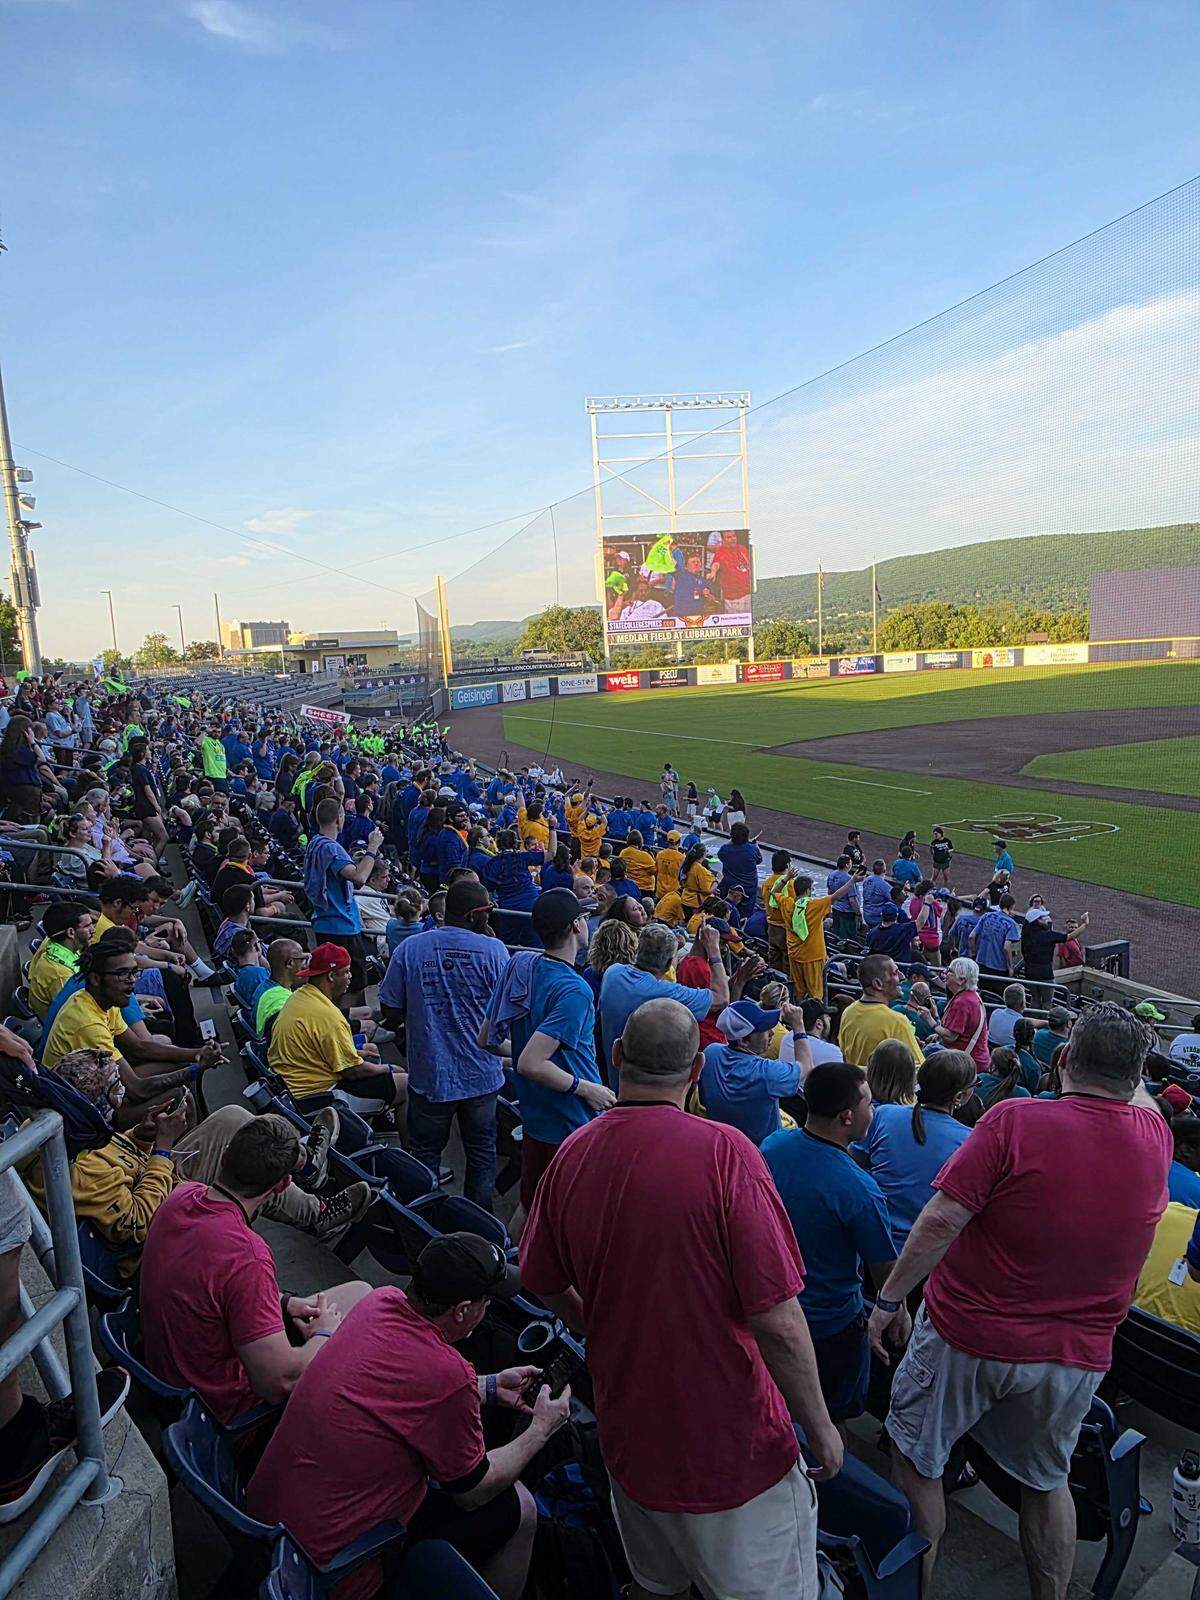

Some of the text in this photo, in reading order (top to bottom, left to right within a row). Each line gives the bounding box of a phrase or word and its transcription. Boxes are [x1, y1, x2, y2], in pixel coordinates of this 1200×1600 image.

[617, 627, 742, 642] MEDLAR FIELD AT LUBRANO PARK
[608, 673, 638, 685] weis
[659, 669, 678, 680] PSECU
[457, 687, 494, 704] Geisinger
[307, 709, 345, 721] SHEETZ
